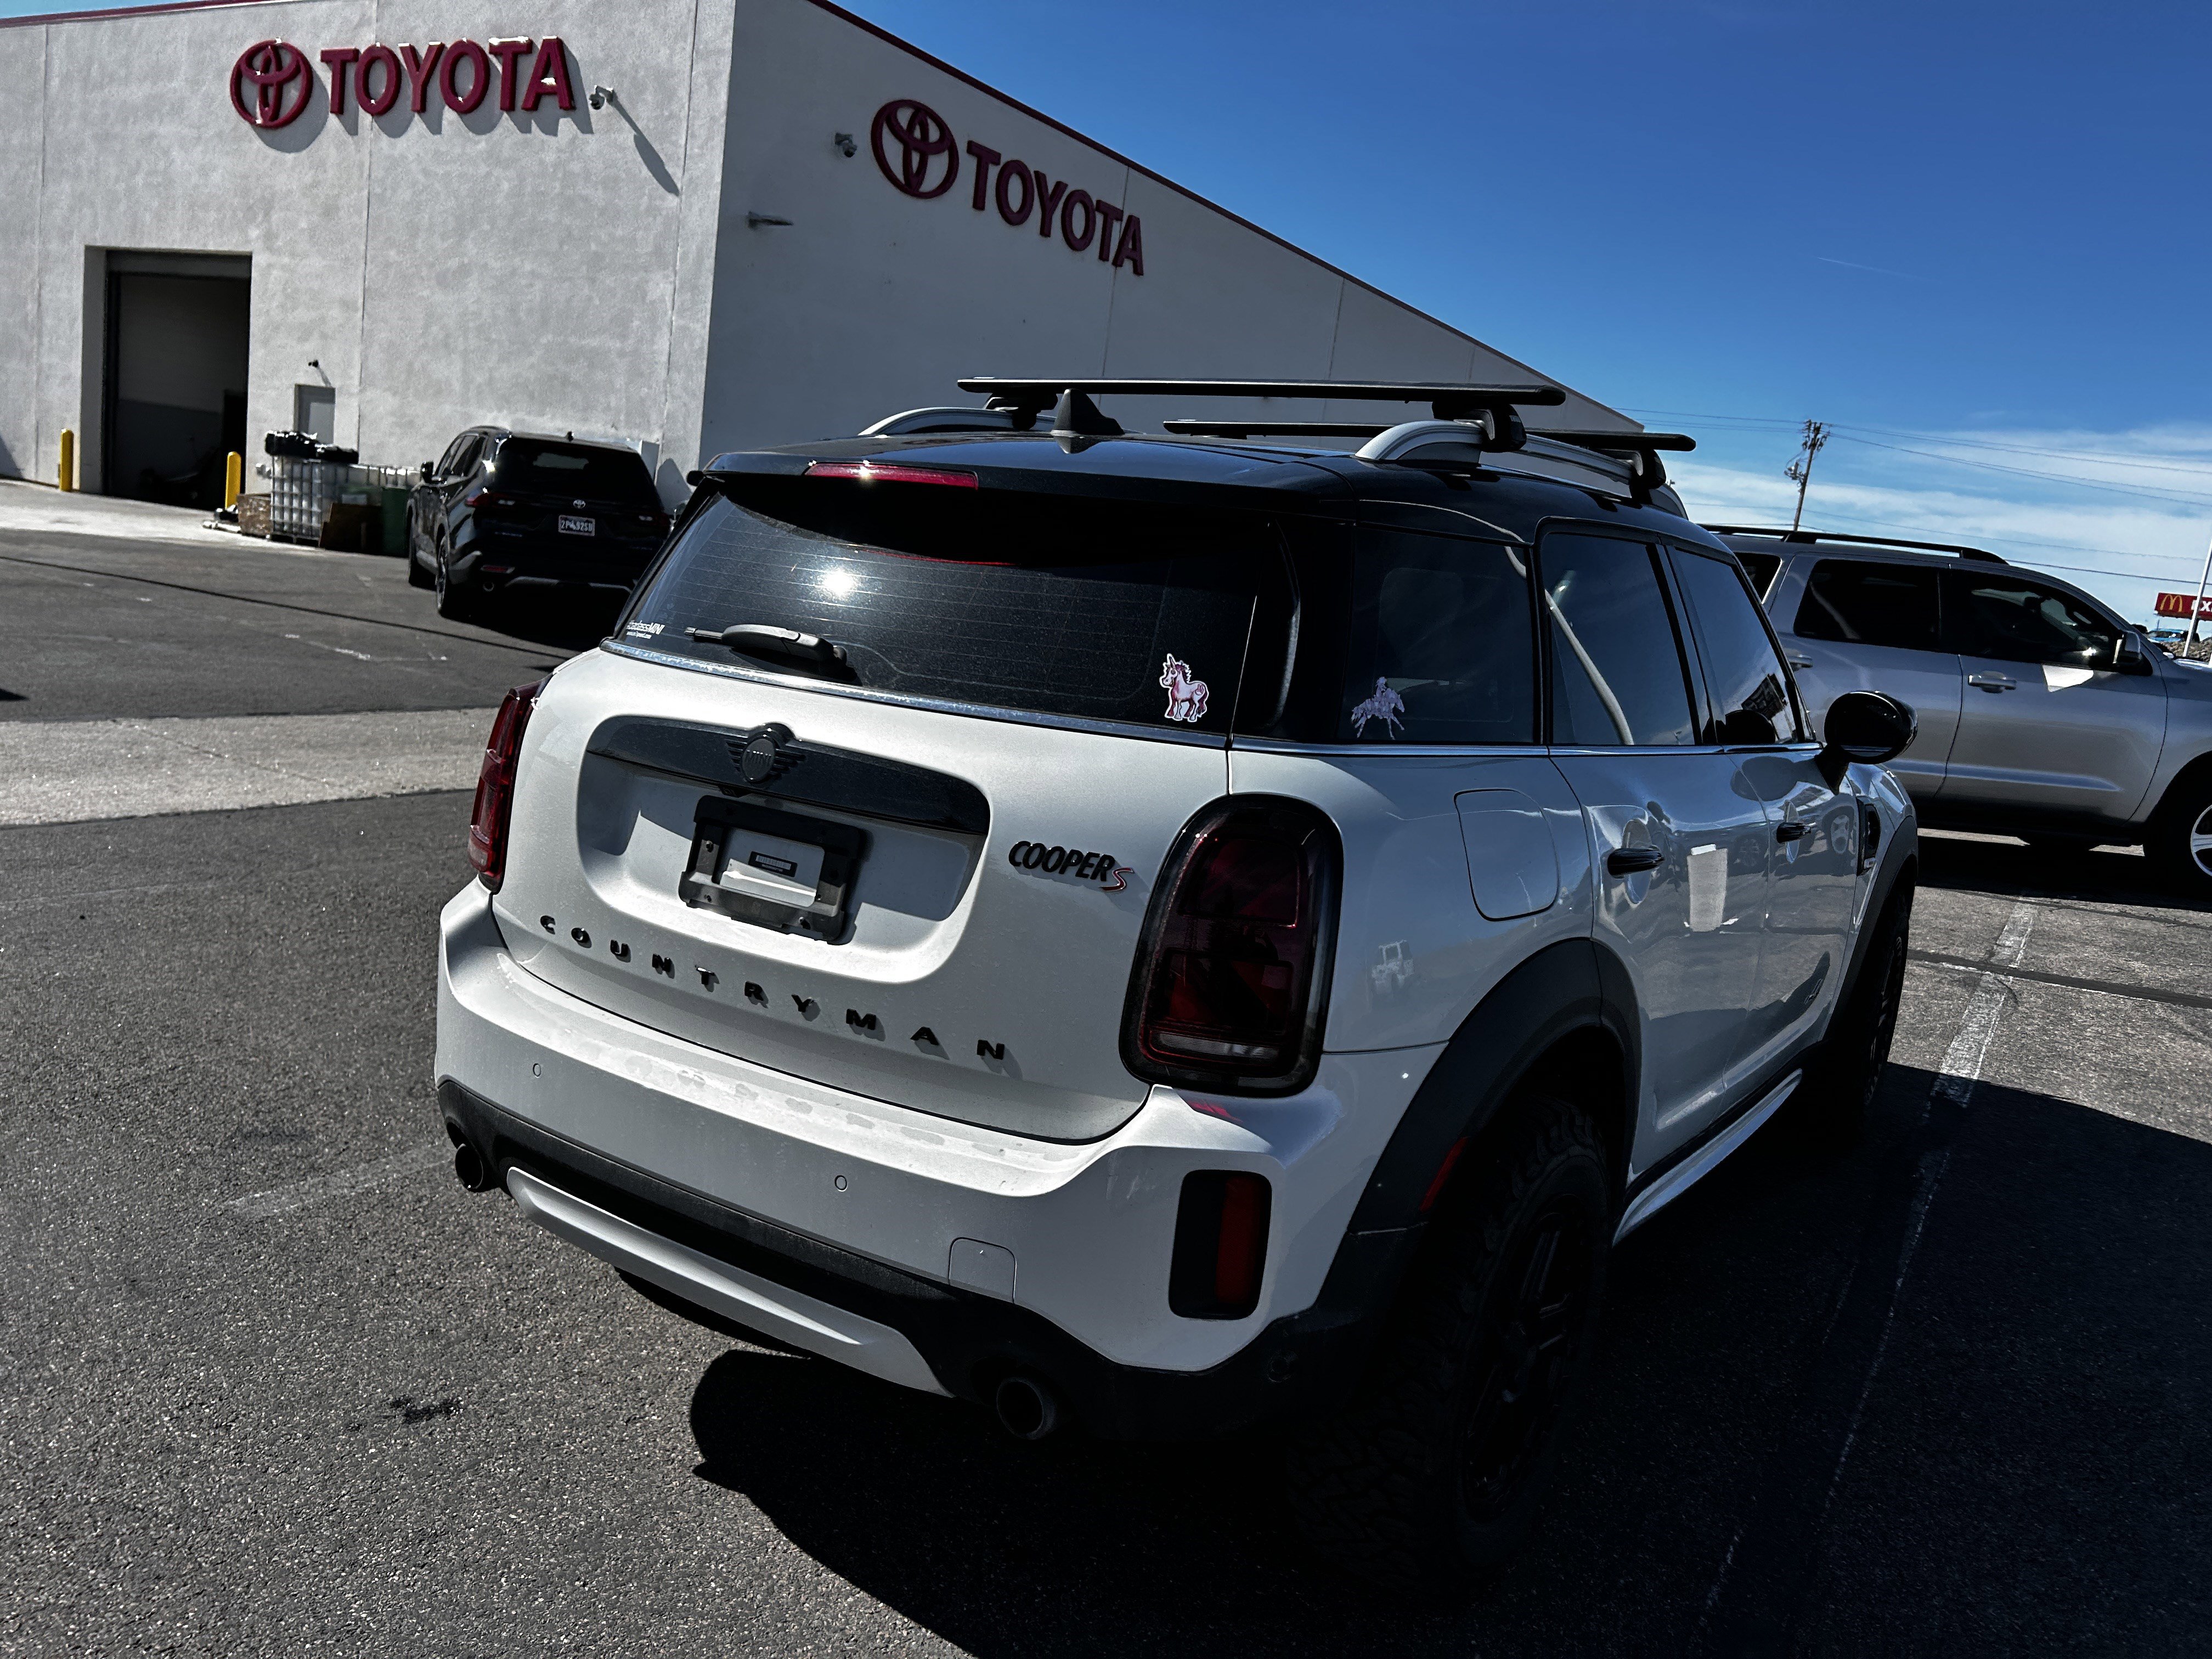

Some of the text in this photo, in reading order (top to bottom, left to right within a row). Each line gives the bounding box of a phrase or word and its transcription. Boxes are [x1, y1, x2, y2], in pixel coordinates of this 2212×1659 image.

[321, 36, 576, 116] TOYOTA
[967, 140, 1144, 276] TOYOTA
[1008, 840, 1115, 882] COOPER
[540, 915, 1005, 1060] COUNTRYMAN
